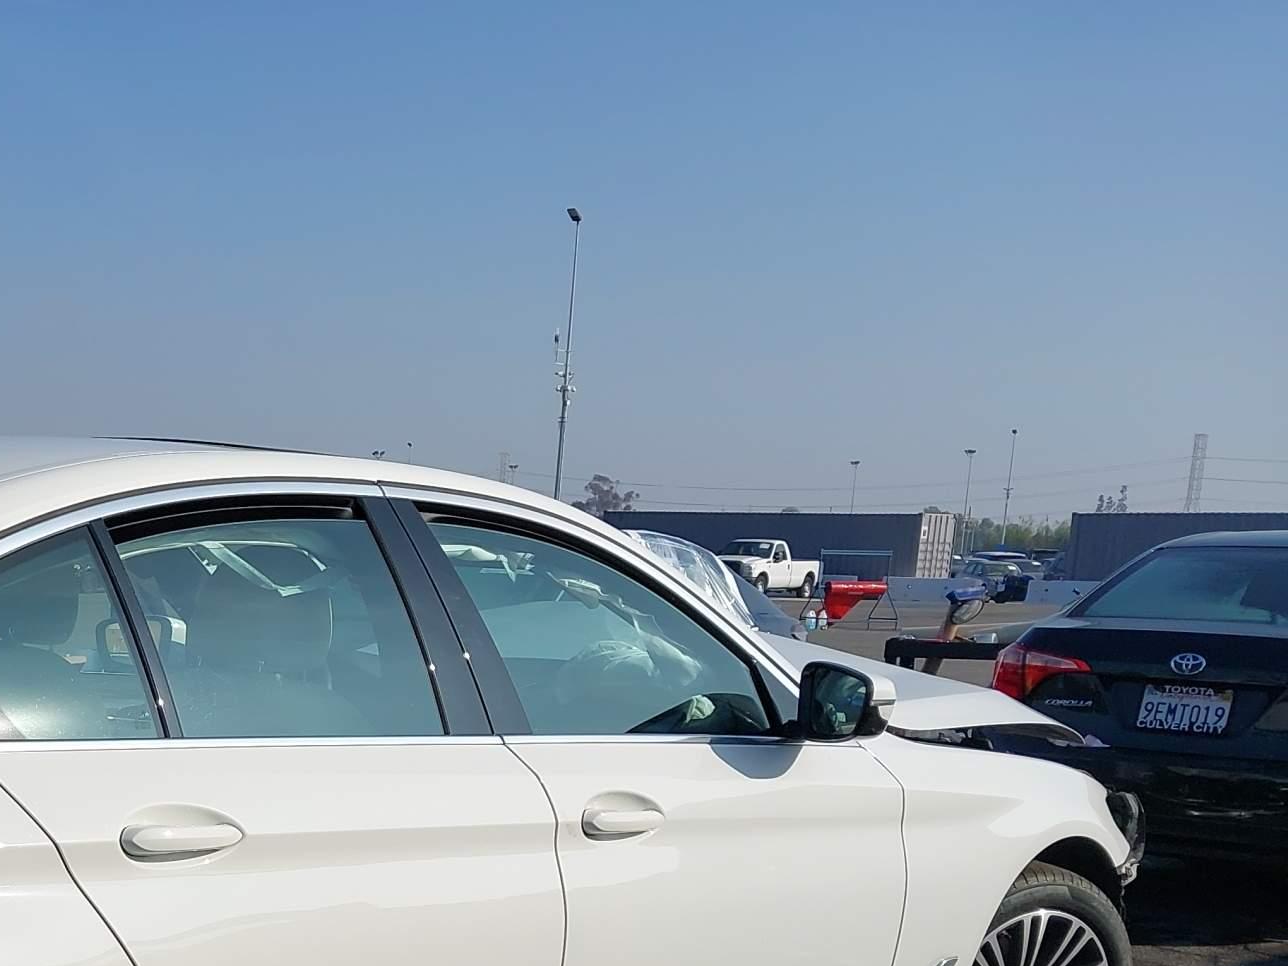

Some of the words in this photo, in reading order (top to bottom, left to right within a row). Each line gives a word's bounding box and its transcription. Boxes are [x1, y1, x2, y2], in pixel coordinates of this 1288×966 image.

[1163, 685, 1215, 696] TOYOTA
[1143, 701, 1226, 726] 9EMT019
[1136, 719, 1189, 732] CULVER
[1193, 722, 1225, 735] CITY
